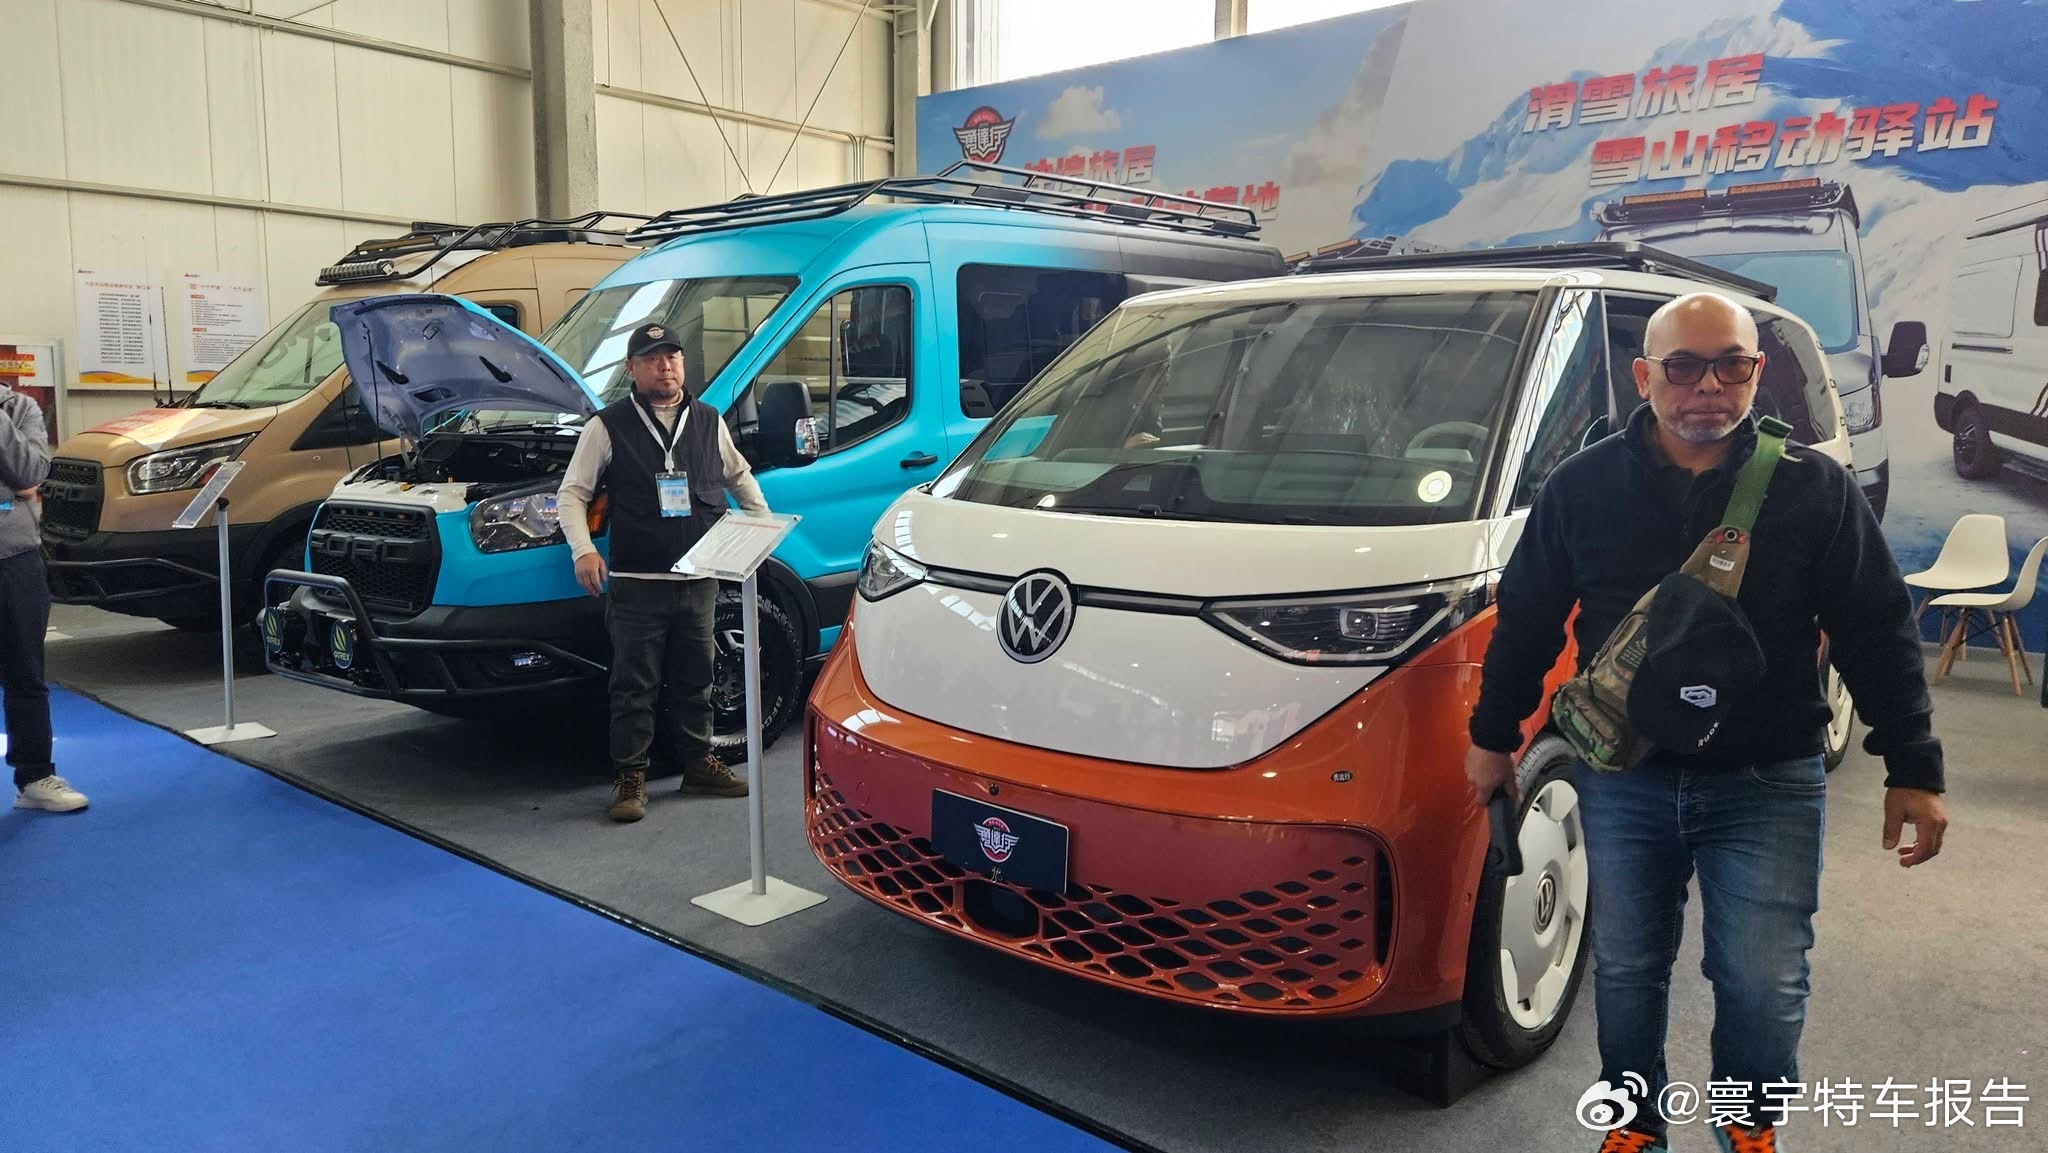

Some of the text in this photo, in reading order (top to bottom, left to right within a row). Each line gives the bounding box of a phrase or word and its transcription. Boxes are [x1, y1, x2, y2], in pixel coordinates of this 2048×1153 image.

[1521, 53, 1764, 133] 滑雪旅居
[1589, 93, 1999, 187] 雪山移动驿站
